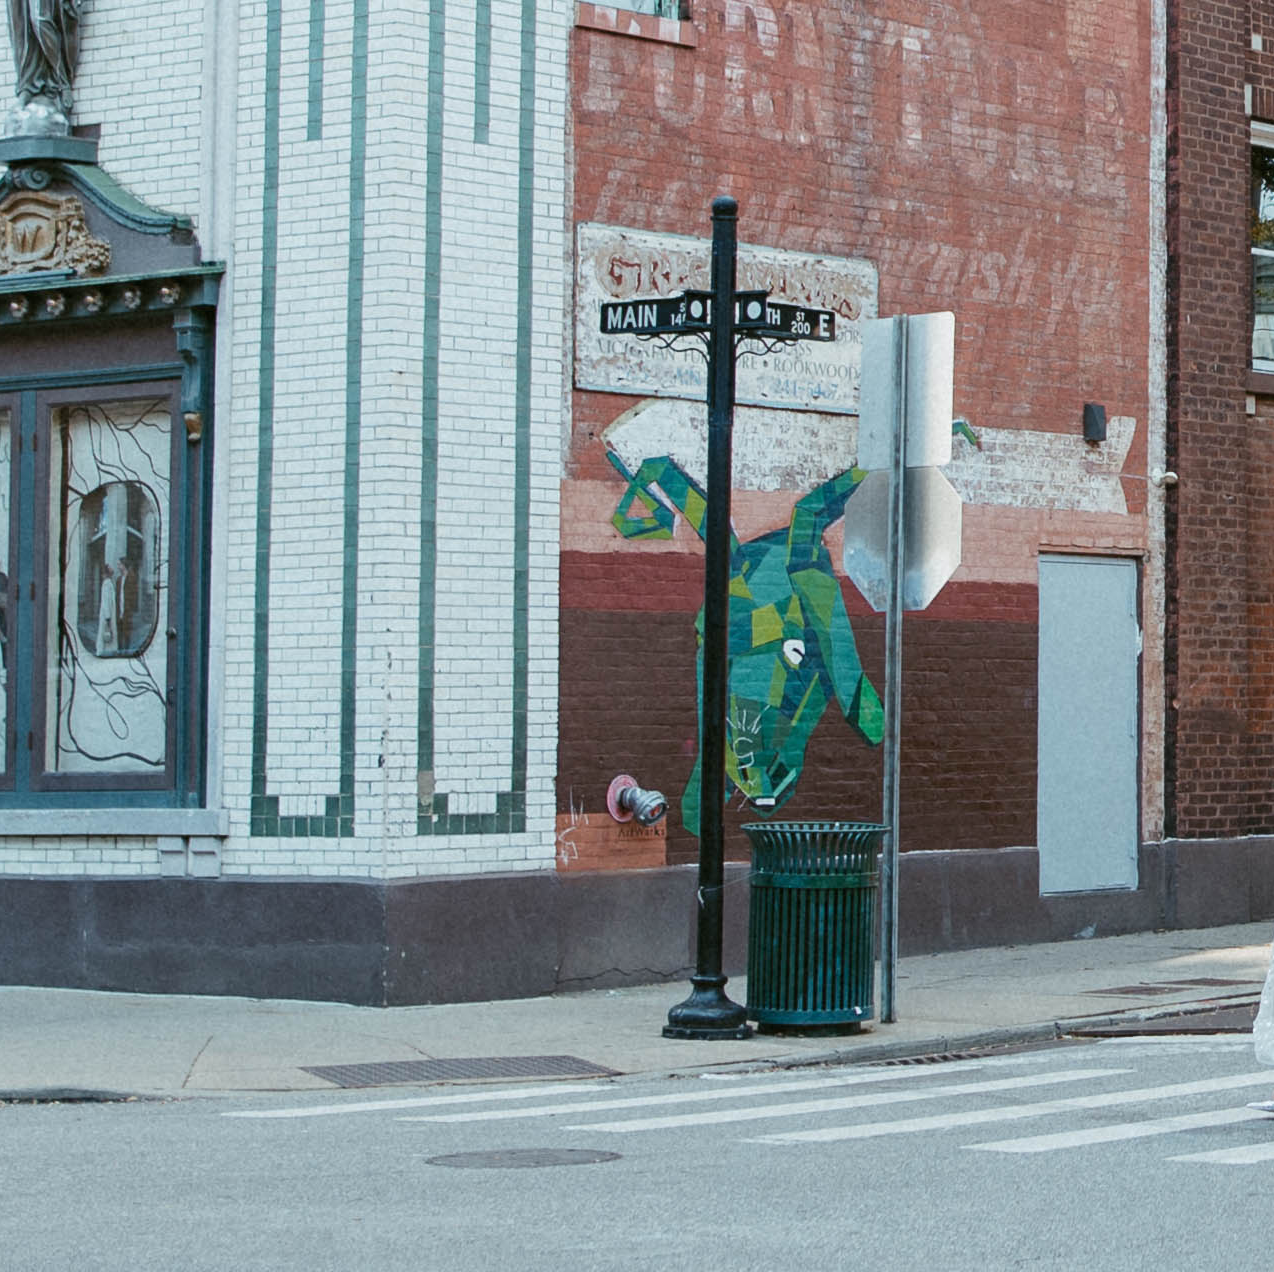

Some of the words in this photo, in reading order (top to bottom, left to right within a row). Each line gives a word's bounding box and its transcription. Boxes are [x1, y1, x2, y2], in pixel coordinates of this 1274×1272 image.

[607, 304, 658, 329] MAIN
[679, 302, 686, 313] S
[791, 321, 811, 334] 200
[795, 311, 806, 322] ST
[819, 314, 830, 337] E
